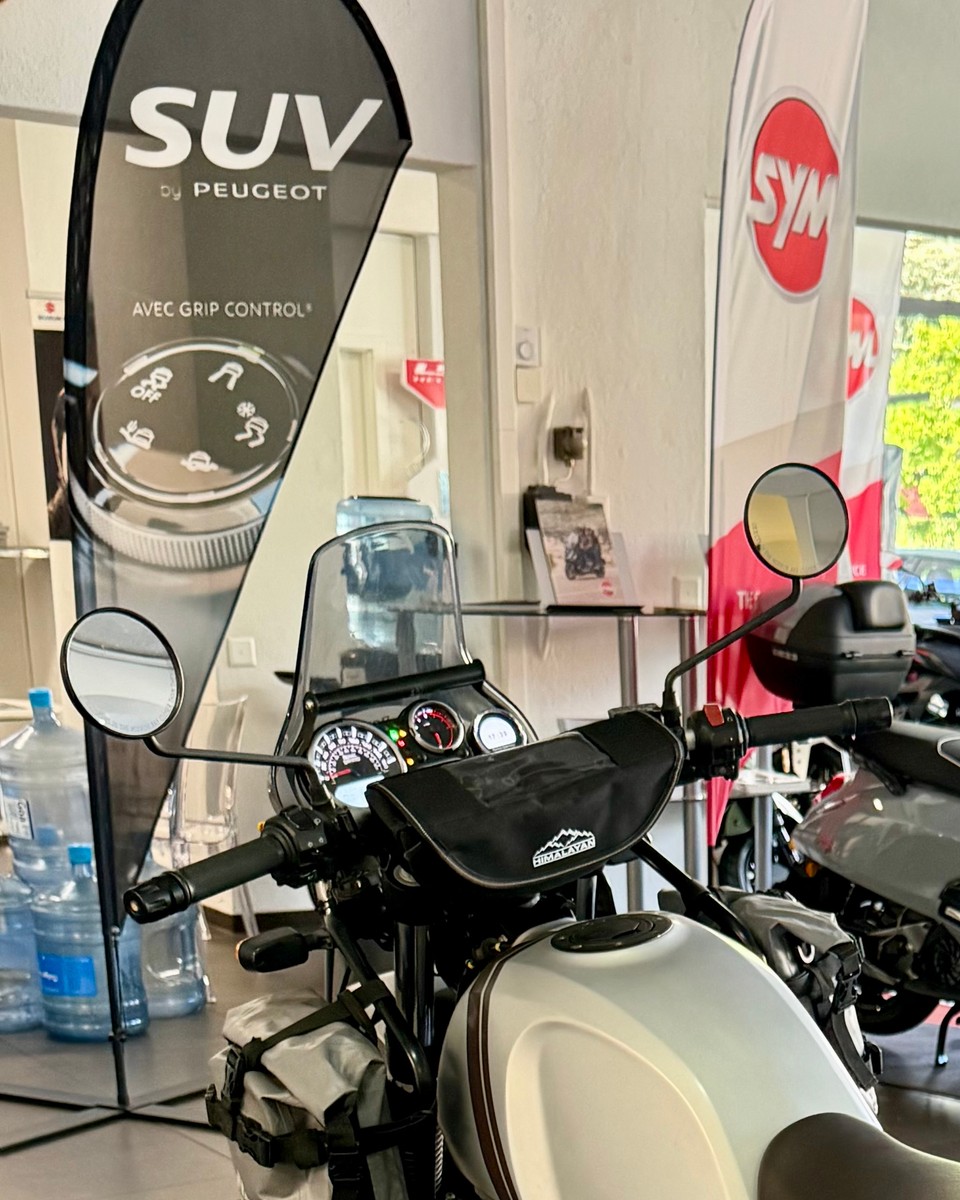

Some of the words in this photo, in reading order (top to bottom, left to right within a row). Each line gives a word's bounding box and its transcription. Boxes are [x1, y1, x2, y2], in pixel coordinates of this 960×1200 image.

[125, 86, 383, 171] SUV
[160, 184, 182, 200] by
[193, 182, 328, 201] PEUGEOT
[746, 152, 838, 251] SYM
[132, 301, 175, 318] AVEC
[179, 302, 220, 318] GRIP
[130, 385, 162, 403] OFF
[533, 837, 596, 868] HIMALAYAN
